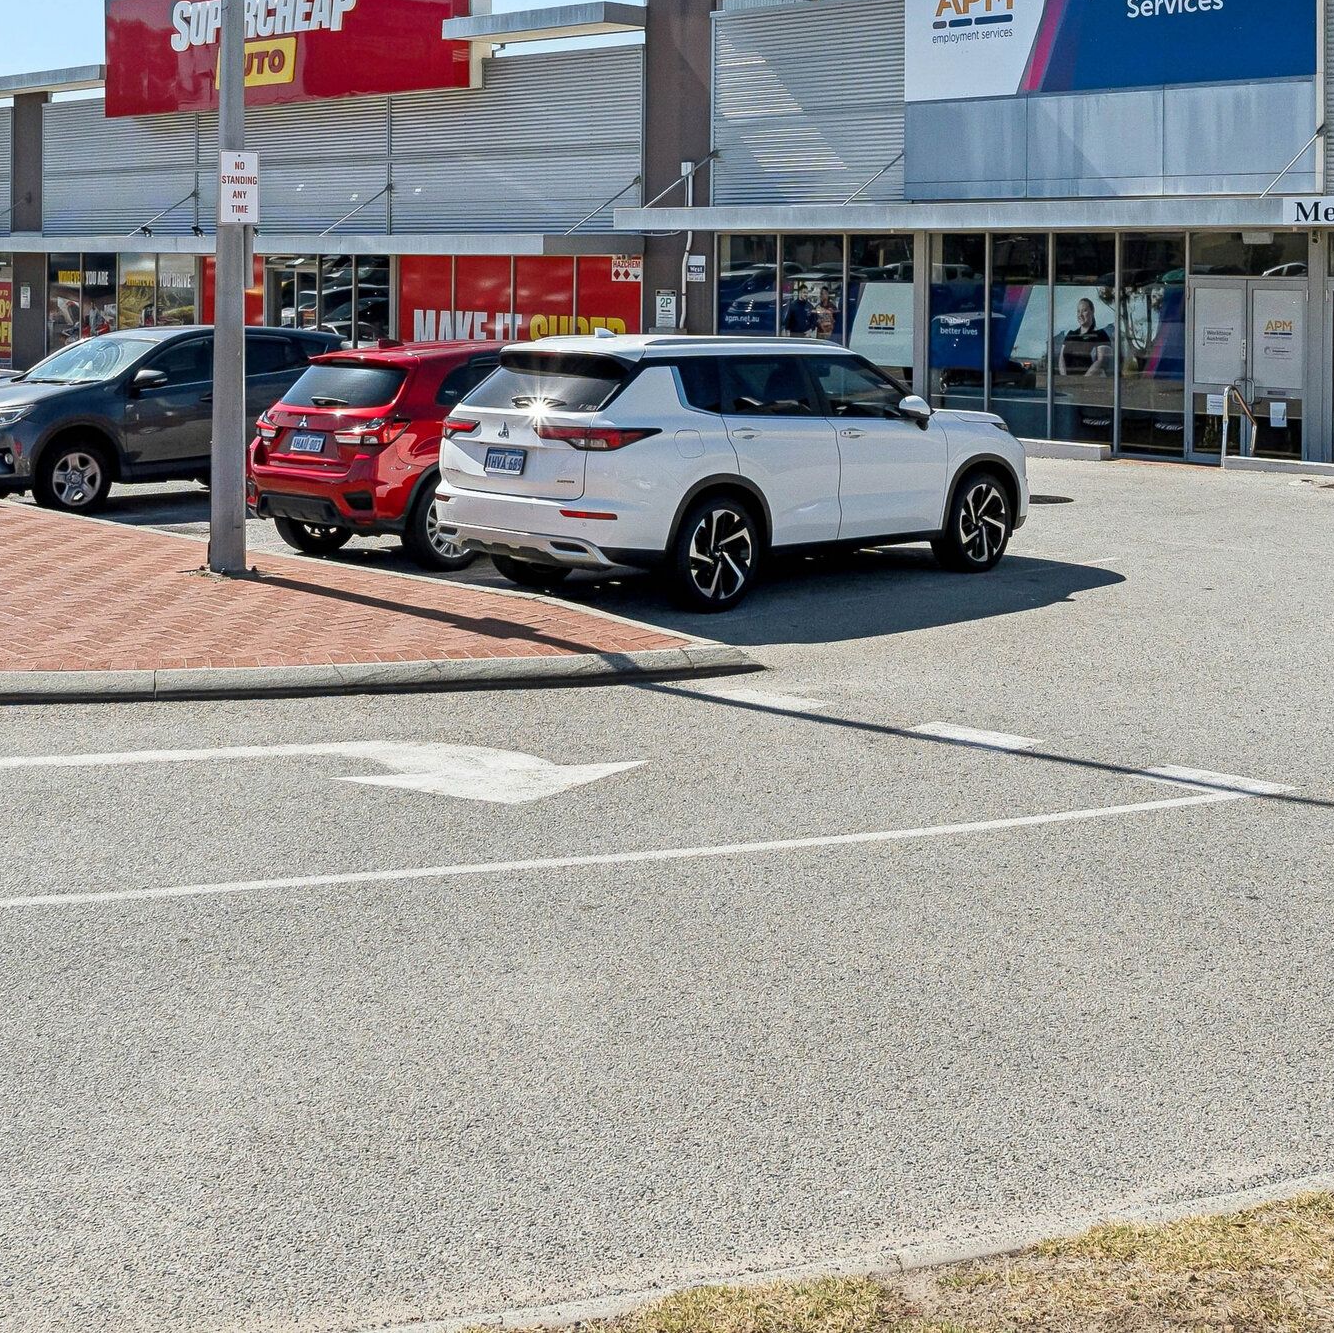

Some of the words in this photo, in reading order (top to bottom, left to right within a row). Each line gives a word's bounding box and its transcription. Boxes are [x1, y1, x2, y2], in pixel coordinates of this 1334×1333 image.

[931, 30, 980, 46] employment
[980, 27, 1013, 40] services
[244, 48, 286, 77] UTO
[234, 161, 245, 170] NO
[221, 175, 258, 185] STANDING
[232, 190, 248, 199] ANY
[230, 204, 249, 214] TIME
[612, 260, 641, 268] HAZCHEM
[85, 270, 97, 285] YOU
[97, 270, 109, 285] ARE
[660, 297, 672, 308] 2P
[724, 314, 760, 325] apm.net.au
[869, 313, 896, 327] APM
[940, 316, 971, 327] Enabling
[413, 309, 488, 343] MAKE
[495, 312, 523, 342] IT
[940, 326, 960, 335] better
[960, 326, 978, 336] lives
[1264, 319, 1293, 332] APM
